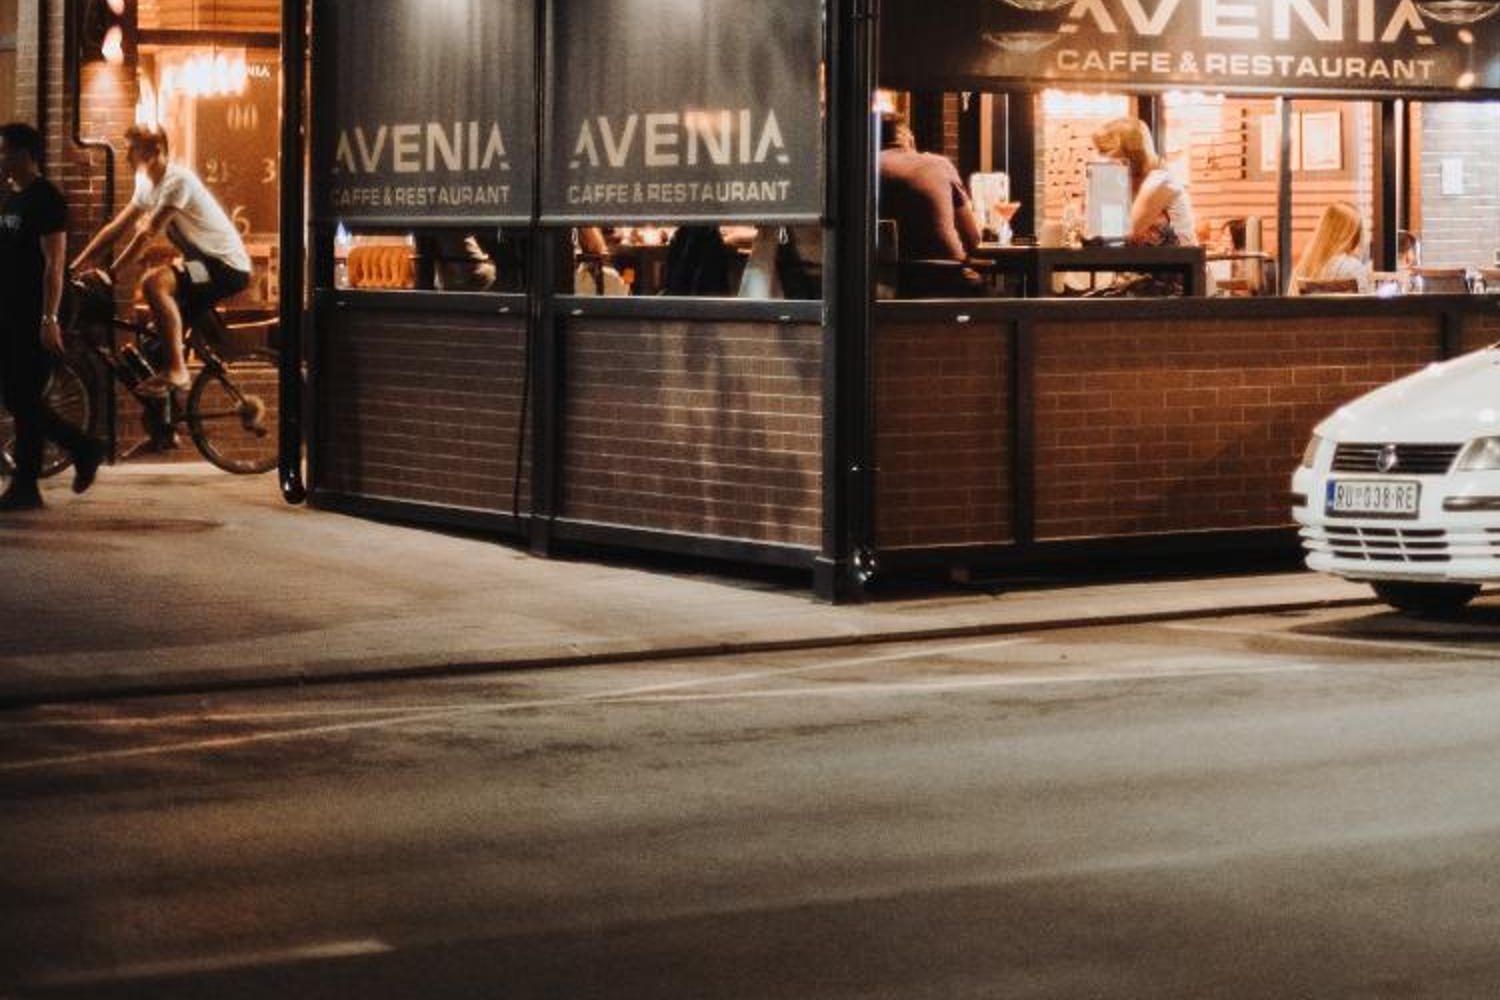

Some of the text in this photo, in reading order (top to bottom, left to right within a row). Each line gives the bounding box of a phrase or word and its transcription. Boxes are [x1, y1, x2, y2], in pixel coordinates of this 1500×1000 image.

[1056, 49, 1434, 81] CAFFE & RESTAURANT
[332, 121, 511, 174] AVENIA
[568, 107, 790, 169] AVENIA
[332, 184, 511, 206] CAFFE & RESTAURANT
[567, 180, 790, 204] CAFFE & RESTAURANT
